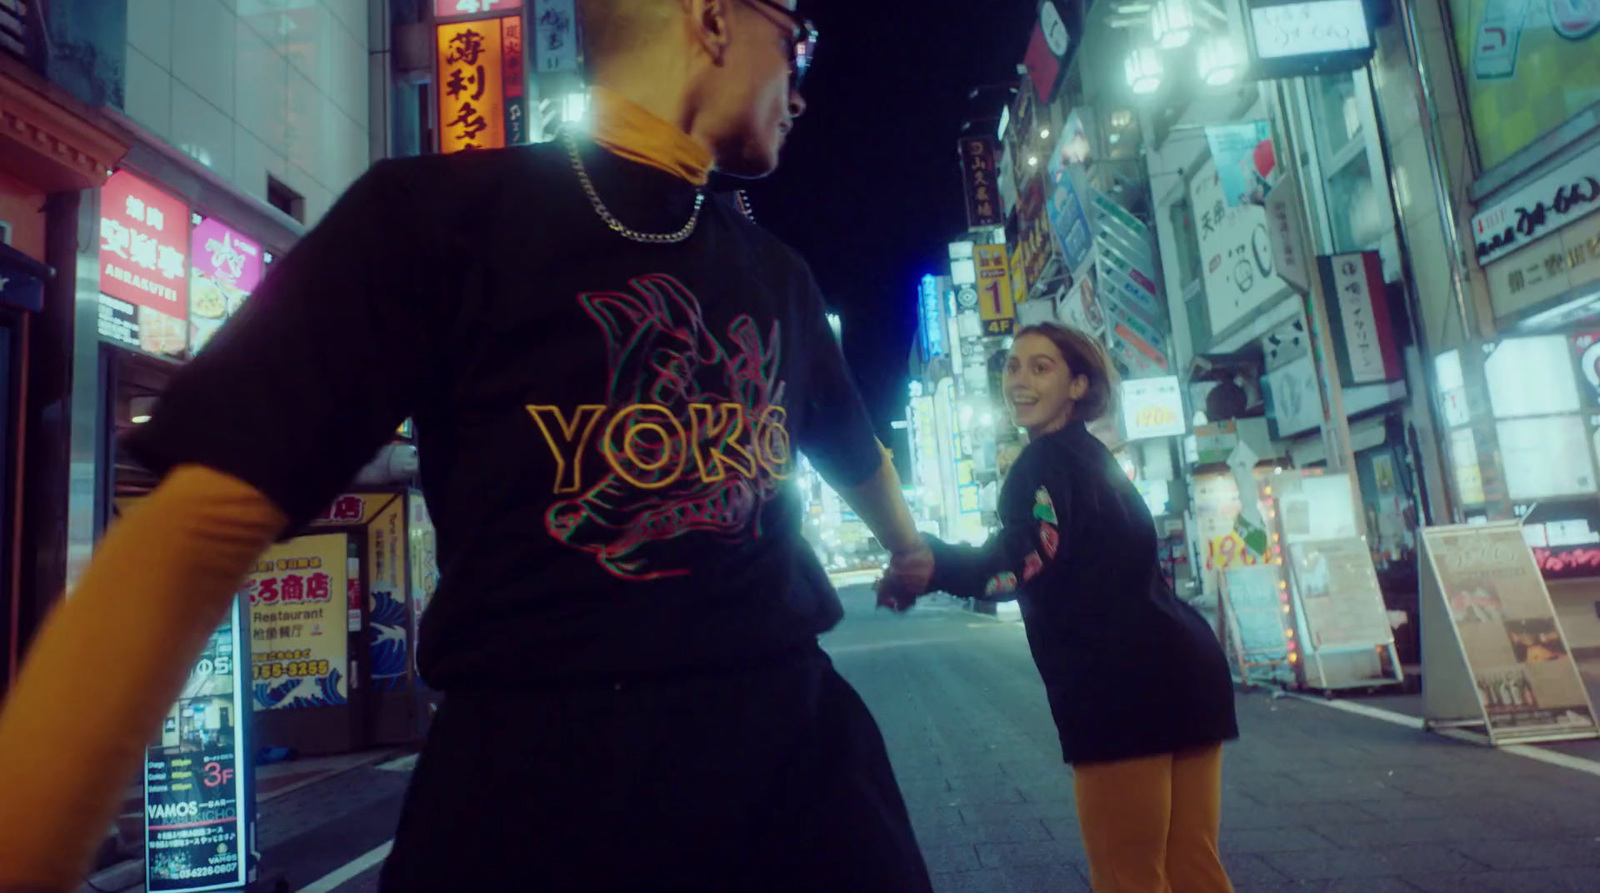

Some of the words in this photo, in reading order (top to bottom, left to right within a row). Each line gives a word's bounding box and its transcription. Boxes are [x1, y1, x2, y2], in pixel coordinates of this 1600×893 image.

[446, 28, 487, 150] 薄利多
[253, 608, 324, 622] Restaurant
[204, 761, 234, 787] 3F
[148, 800, 198, 819] VAMOS
